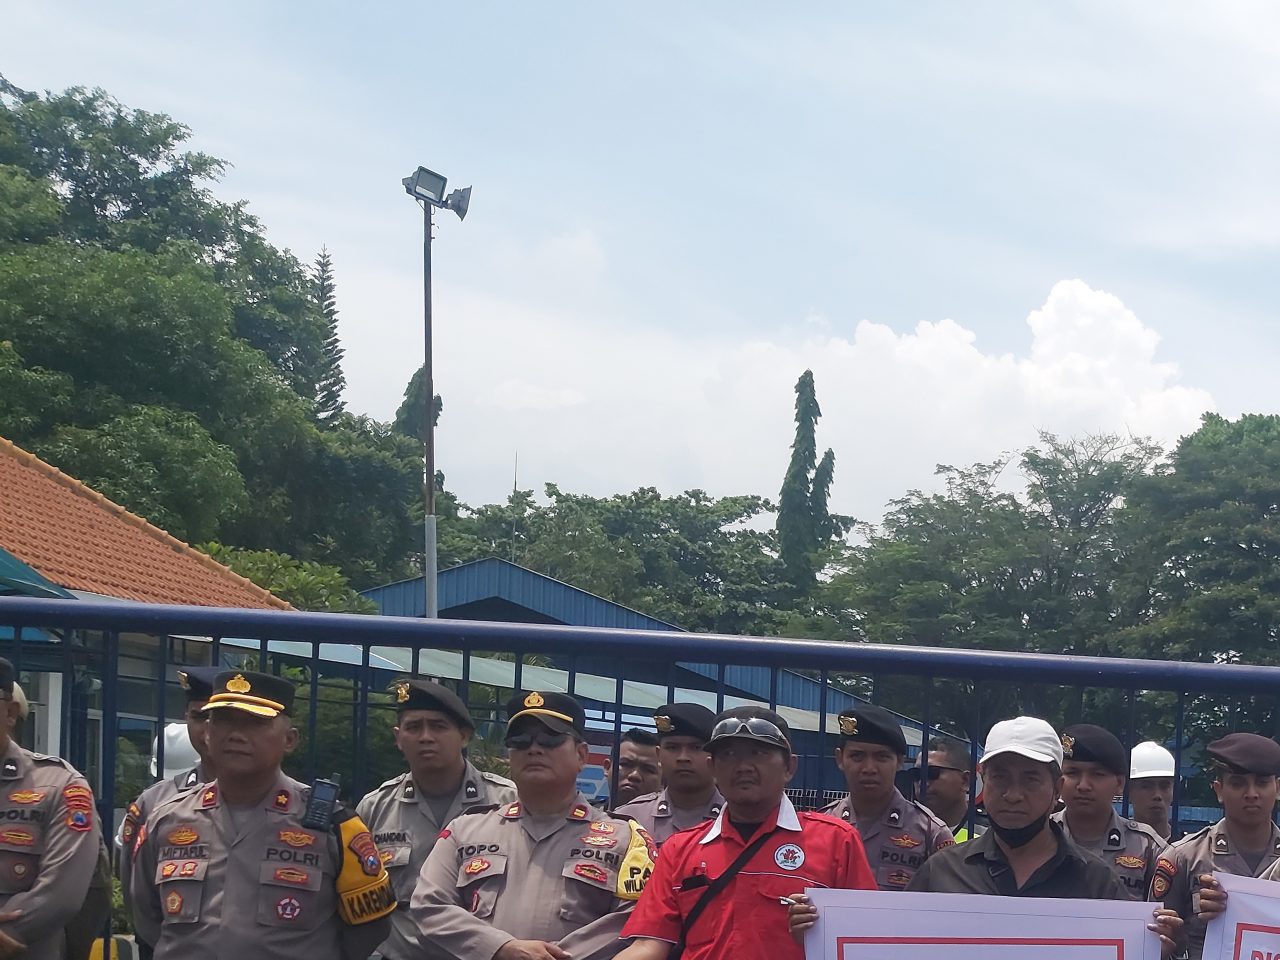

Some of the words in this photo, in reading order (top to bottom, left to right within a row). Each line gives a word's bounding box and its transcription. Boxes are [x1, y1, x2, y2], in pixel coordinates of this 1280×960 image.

[266, 847, 320, 866] POLRI
[457, 844, 500, 860] TOPO
[570, 848, 620, 866] POLRI
[881, 850, 923, 866] POLRI
